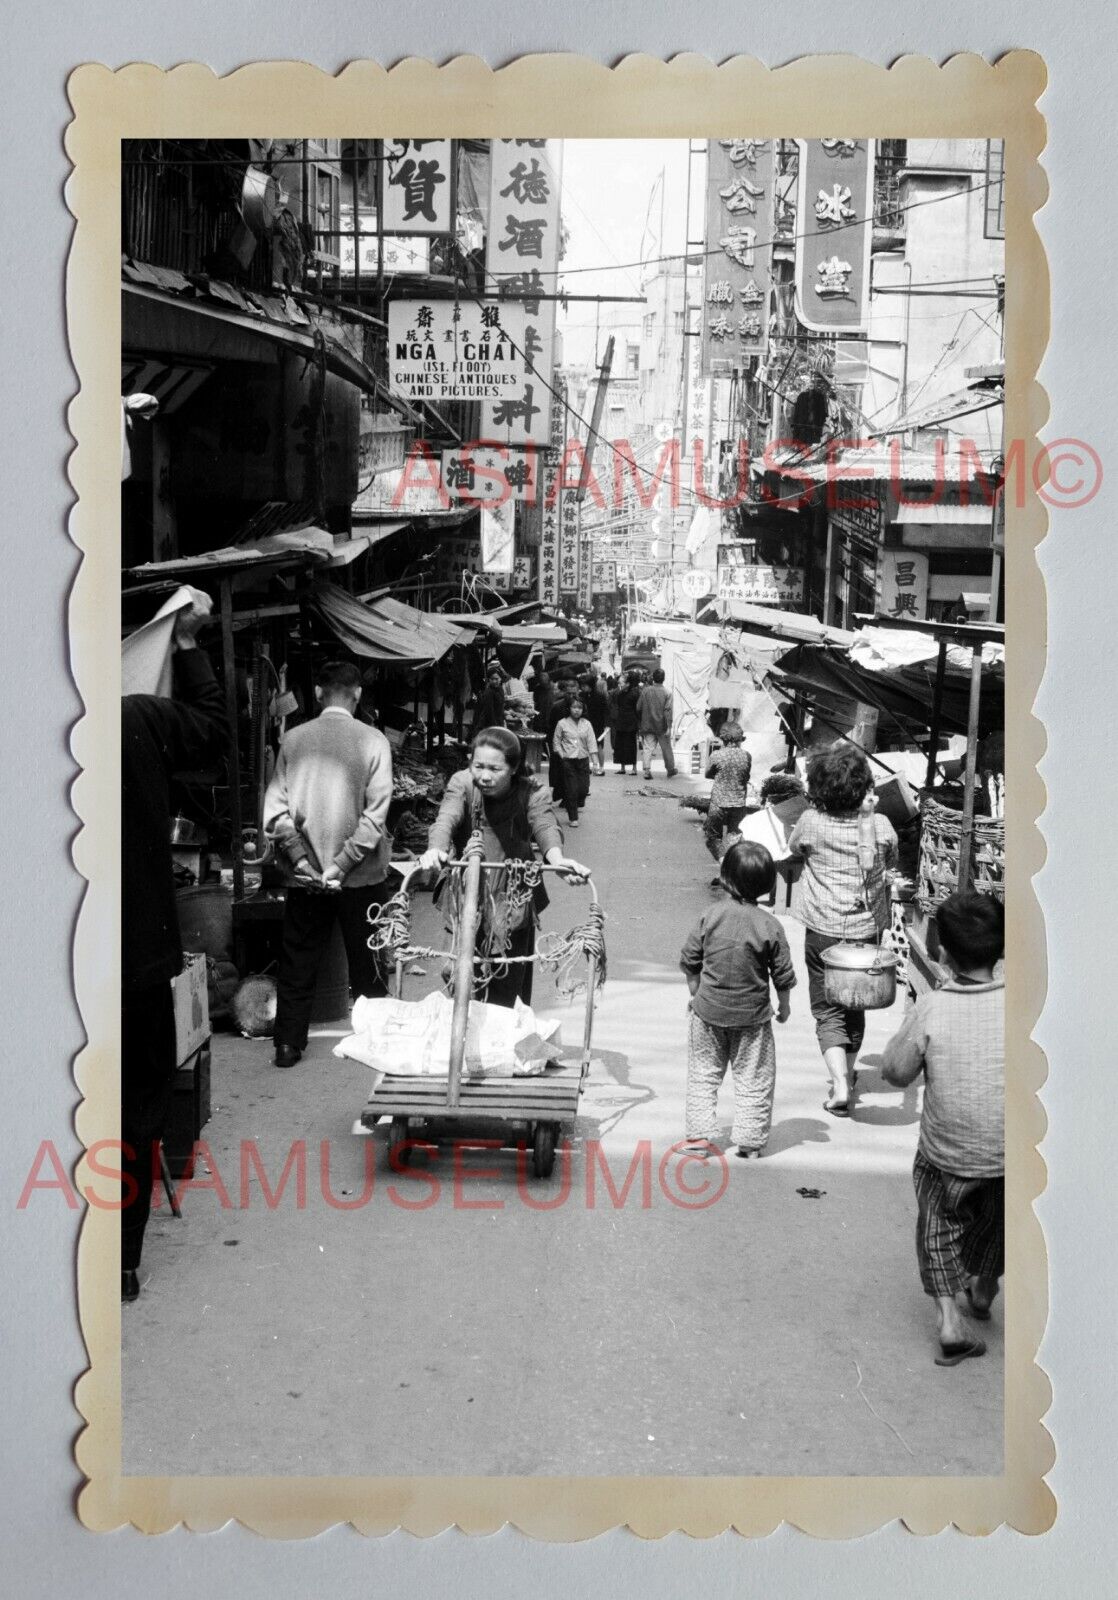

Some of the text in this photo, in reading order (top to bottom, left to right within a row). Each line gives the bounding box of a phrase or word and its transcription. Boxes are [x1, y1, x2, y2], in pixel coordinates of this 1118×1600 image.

[395, 343, 516, 360] NGA CHAI
[395, 373, 517, 385] CHINESE ANTIQUES
[409, 385, 503, 397] AND PICTURES.
